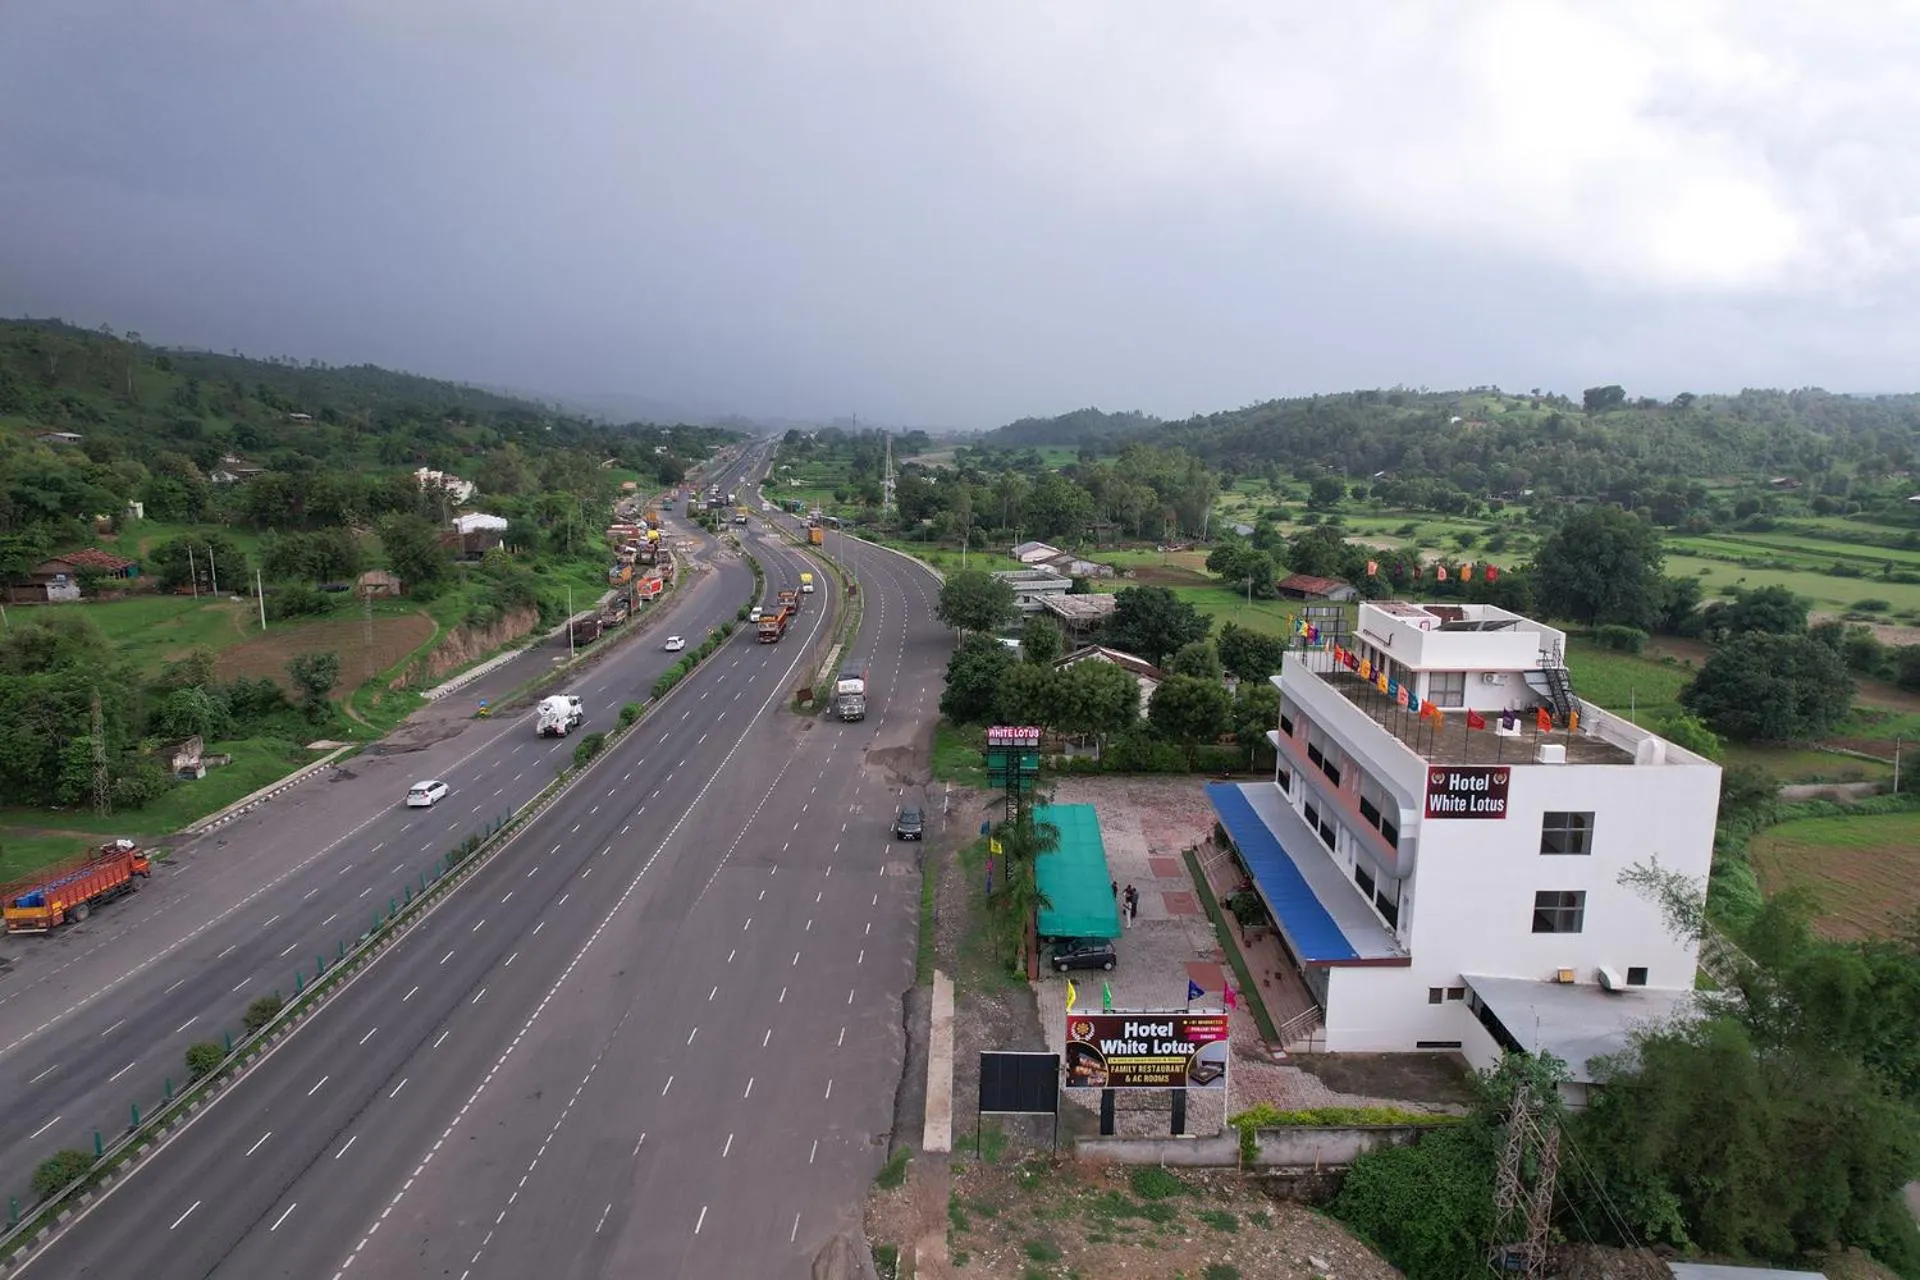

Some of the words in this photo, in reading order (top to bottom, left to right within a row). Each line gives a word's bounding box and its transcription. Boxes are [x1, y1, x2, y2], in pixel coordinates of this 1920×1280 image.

[988, 729, 1013, 738] WHITE
[1014, 729, 1039, 738] LOTUS
[1449, 774, 1490, 791] Hotel
[1430, 794, 1466, 812] White
[1470, 794, 1505, 812] Lotus
[1124, 1022, 1174, 1038] Hotel
[1101, 1040, 1147, 1054] White
[1153, 1040, 1195, 1054] Lotus
[1111, 1065, 1138, 1073] FAMILY
[1138, 1065, 1184, 1073] RESTAURANT
[1132, 1075, 1142, 1083] AC
[1143, 1075, 1170, 1083] ROOMS
